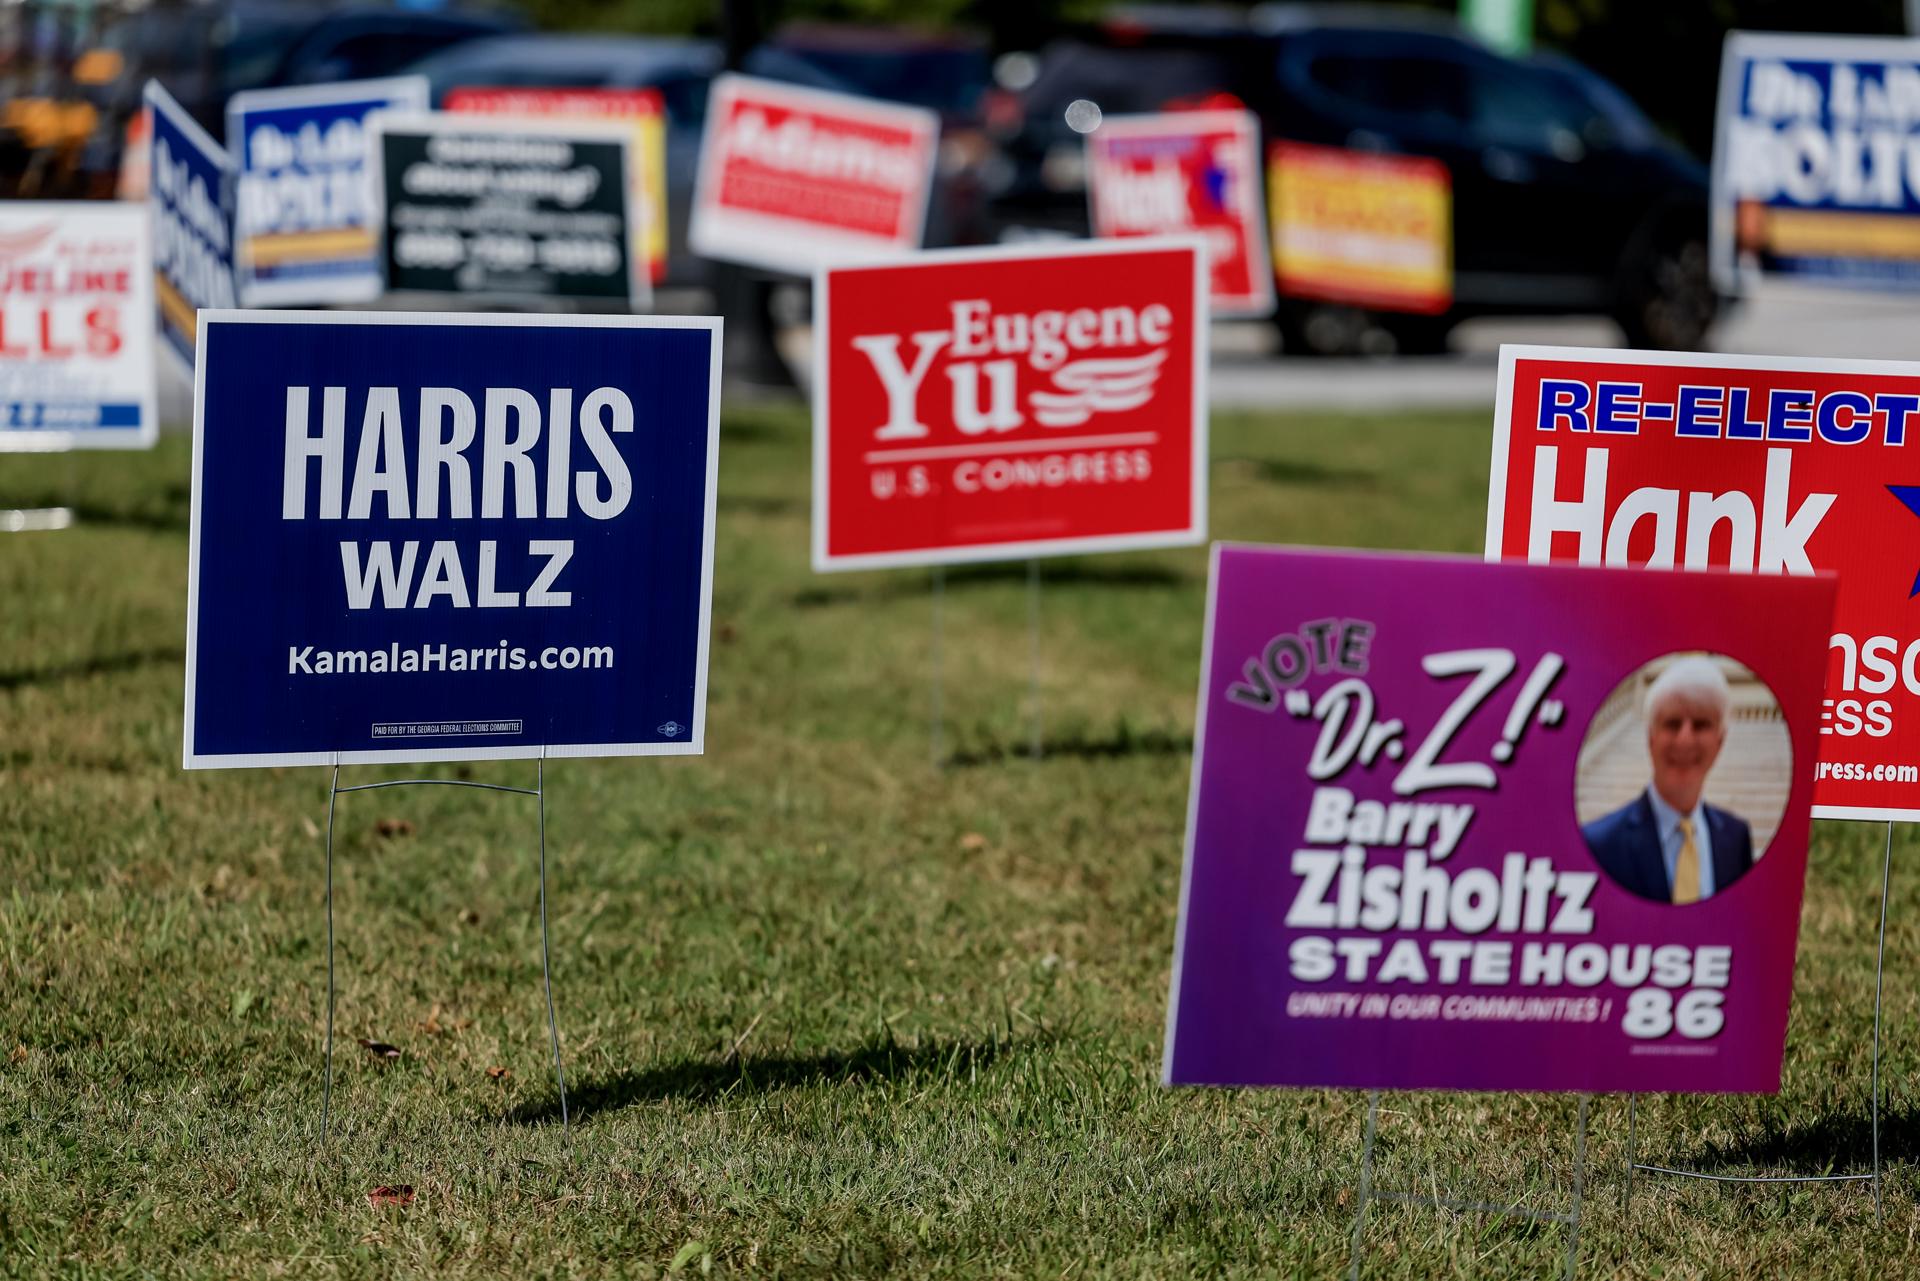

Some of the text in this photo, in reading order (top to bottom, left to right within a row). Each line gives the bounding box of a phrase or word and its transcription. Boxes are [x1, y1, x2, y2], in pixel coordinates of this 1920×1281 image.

[949, 299, 1172, 371] Eugene
[851, 330, 1025, 440] Yu
[1536, 378, 1920, 447] RE-ELECT
[283, 386, 634, 520] HARRIS
[870, 450, 1151, 499] U.S. CONGRESS
[1528, 445, 1838, 577] Hank
[340, 540, 574, 609] WALZ
[288, 640, 614, 675] KamalaHarris.com
[1227, 618, 1375, 712] VOTE
[374, 722, 520, 735] PAID FOR BY THE GEORGIA FEDERAL ELECTIONS COMMITTEE
[1304, 786, 1474, 861] Barry
[1284, 845, 1599, 933] Zisholtz
[1288, 936, 1733, 988] STATE HOUSE
[1286, 991, 1362, 1018] UNITY
[1359, 994, 1390, 1019] IN
[1389, 994, 1441, 1020] OUR
[1621, 986, 1725, 1039] 86
